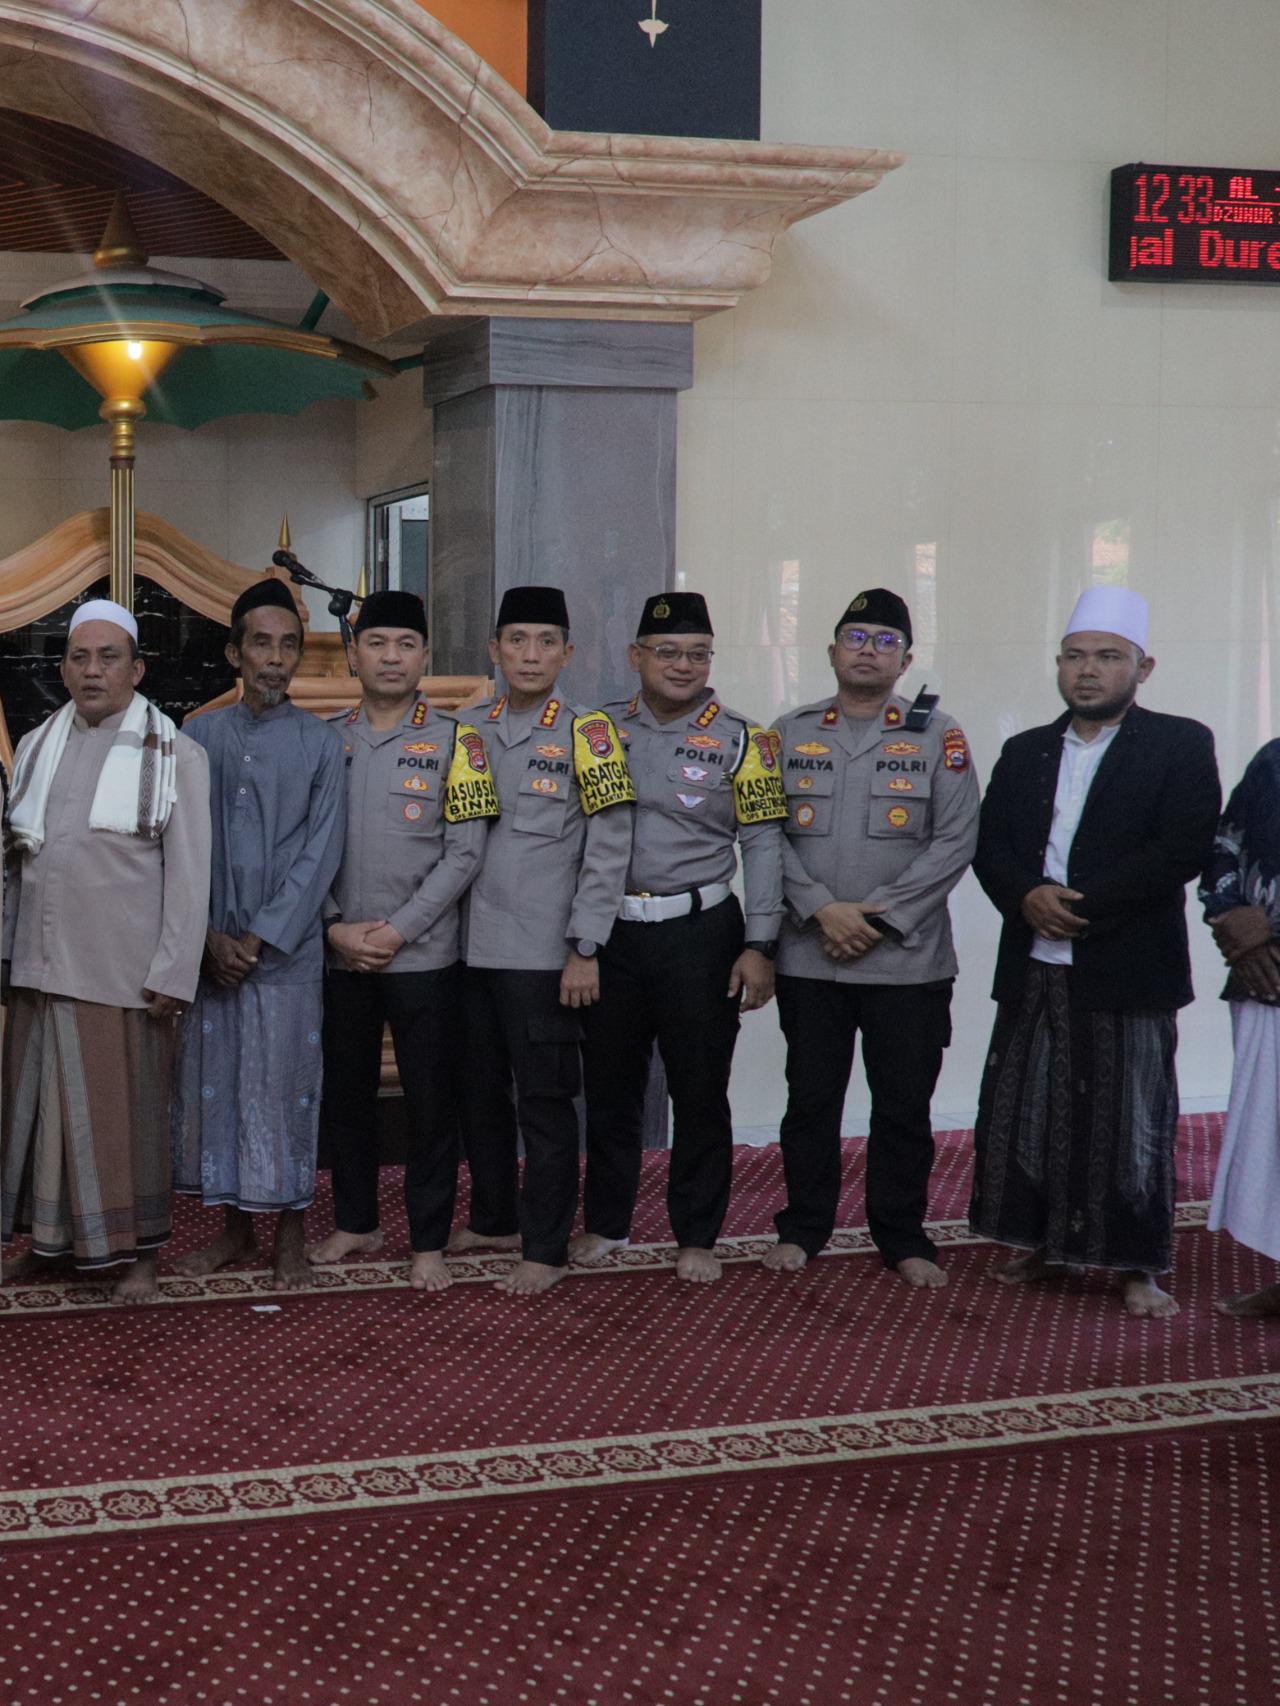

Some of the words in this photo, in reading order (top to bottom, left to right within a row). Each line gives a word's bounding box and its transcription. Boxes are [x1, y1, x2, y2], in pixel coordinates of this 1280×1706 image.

[674, 746, 724, 765] POLRI
[396, 757, 439, 771] POLRI
[527, 758, 570, 774] POLRI
[786, 758, 834, 772] MULYA
[875, 759, 928, 773] POLRI
